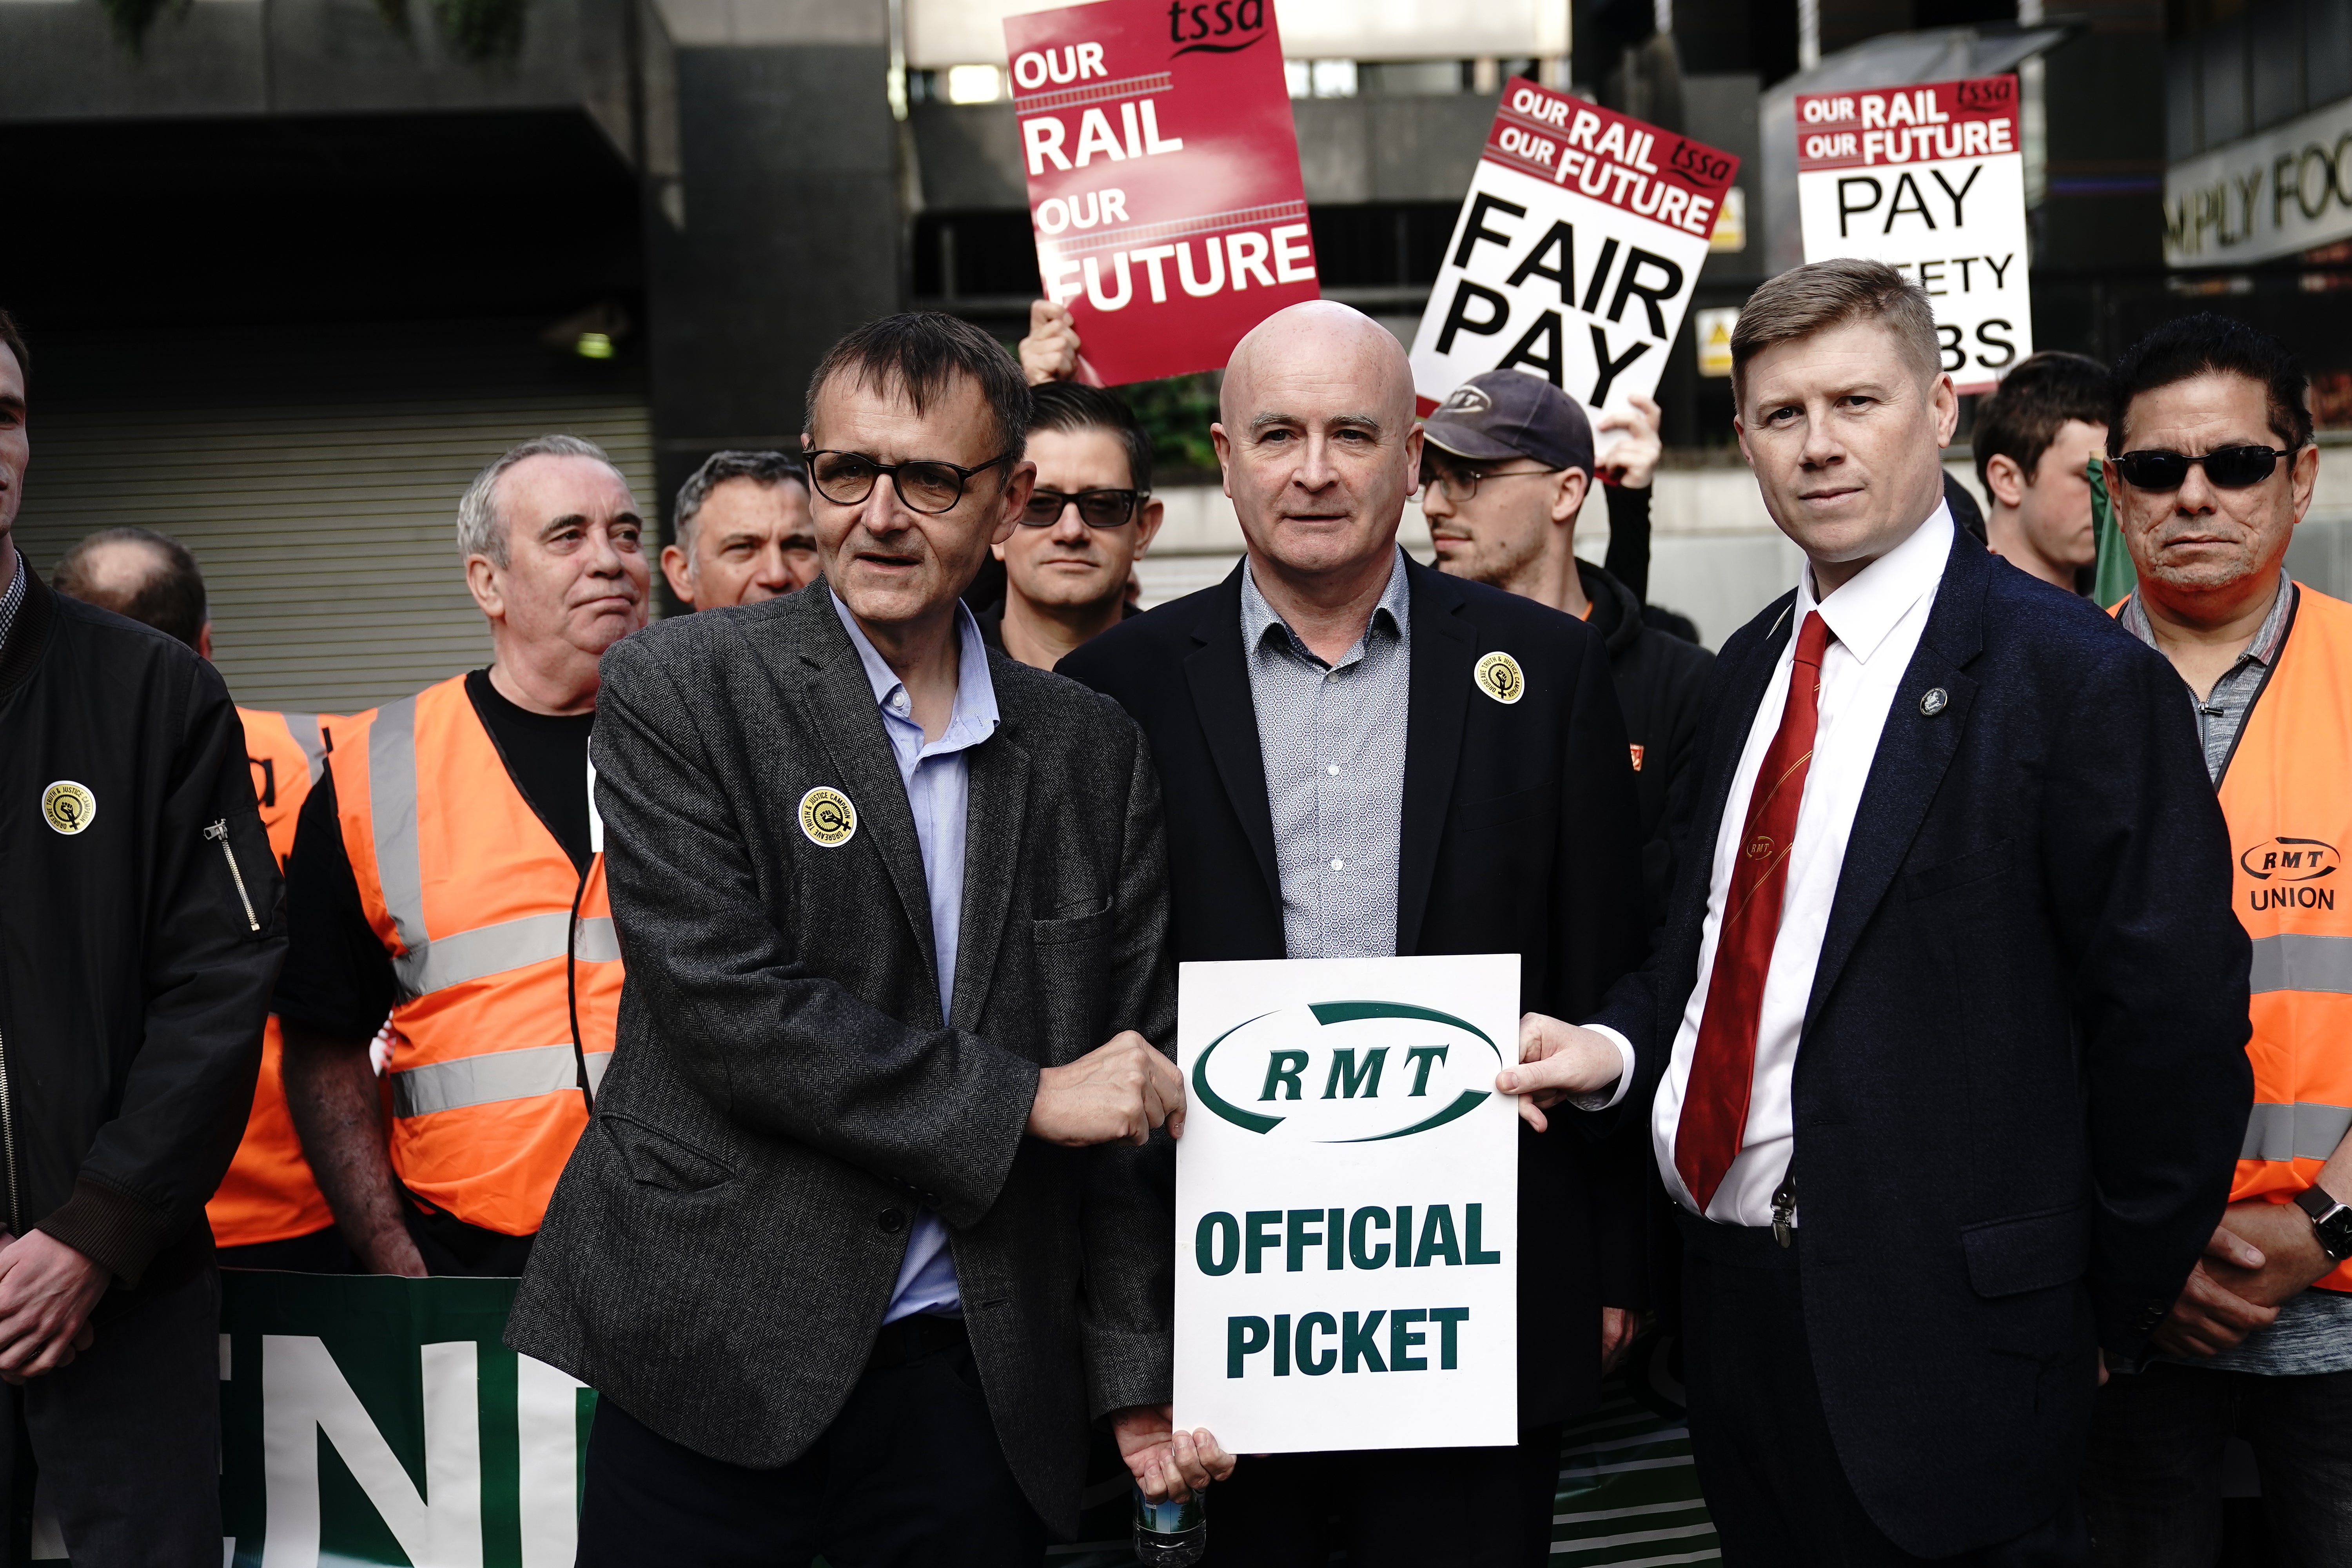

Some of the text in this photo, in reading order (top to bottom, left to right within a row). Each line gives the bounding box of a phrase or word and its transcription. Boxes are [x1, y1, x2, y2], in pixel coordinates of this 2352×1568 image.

[1167, 0, 1263, 42] tssa
[1014, 42, 1107, 89] OUR
[1804, 89, 1949, 130] OUR RAIL
[1956, 81, 2010, 103] tssa
[1022, 99, 1183, 176] RAIL
[1512, 89, 1658, 175] OUR RAIL
[1806, 118, 2013, 165] OUR FUTURE
[1499, 127, 1714, 235] OUR FUTURE
[1668, 140, 1730, 181] tssa
[1036, 188, 1129, 235] OUR
[1838, 164, 1983, 239] PAY
[1040, 223, 1316, 312] FUTURE
[1452, 191, 1684, 341] FAIR
[1434, 279, 1653, 408] PAY
[1936, 319, 2015, 372] BS
[1480, 670, 1496, 693] ORGREAVE
[1482, 657, 1497, 668] TRUTH
[1503, 658, 1518, 675] JUSTICE
[1508, 677, 1520, 698] CAMPAIGN
[47, 790, 56, 805] TRUTH
[63, 787, 83, 797] JUSTICE
[80, 796, 90, 823] CAMPAIGN
[809, 792, 828, 805] JUSTICE
[830, 793, 851, 819] CAMPAIGN
[47, 808, 66, 829] ORGREAVE
[804, 811, 815, 831] TRUTH
[813, 829, 843, 841] ORGREAVE
[1751, 843, 1769, 853] RMT
[2262, 851, 2324, 870] RMT
[2251, 887, 2334, 911] UNION
[1257, 1044, 1449, 1101] RMT
[1195, 1203, 1501, 1276] OFFICIAL
[1227, 1307, 1469, 1379] PICKET
